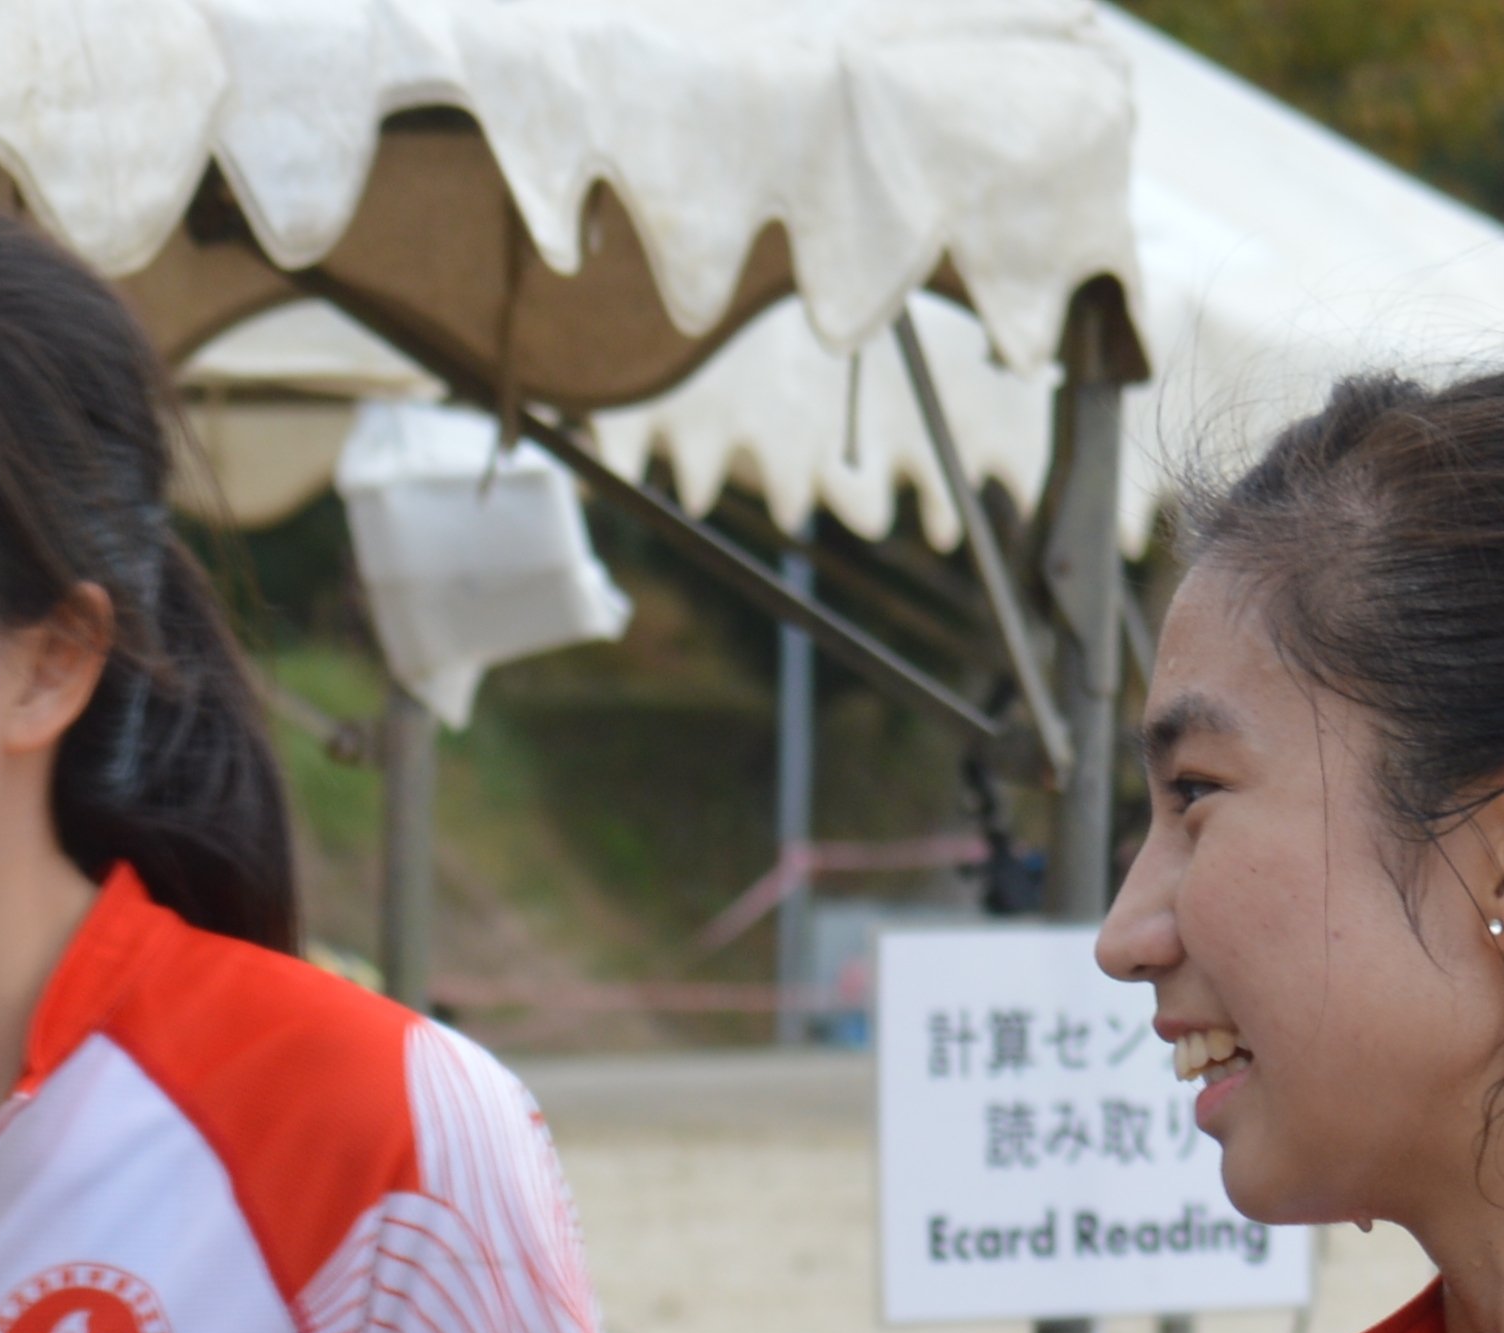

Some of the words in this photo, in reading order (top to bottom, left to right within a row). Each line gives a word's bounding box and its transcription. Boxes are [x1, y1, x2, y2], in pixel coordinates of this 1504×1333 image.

[926, 1009, 1173, 1080] 計算セン
[984, 1097, 1198, 1171] 読み取り
[927, 1206, 1057, 1264] Ecard
[1074, 1201, 1269, 1266] Reading
